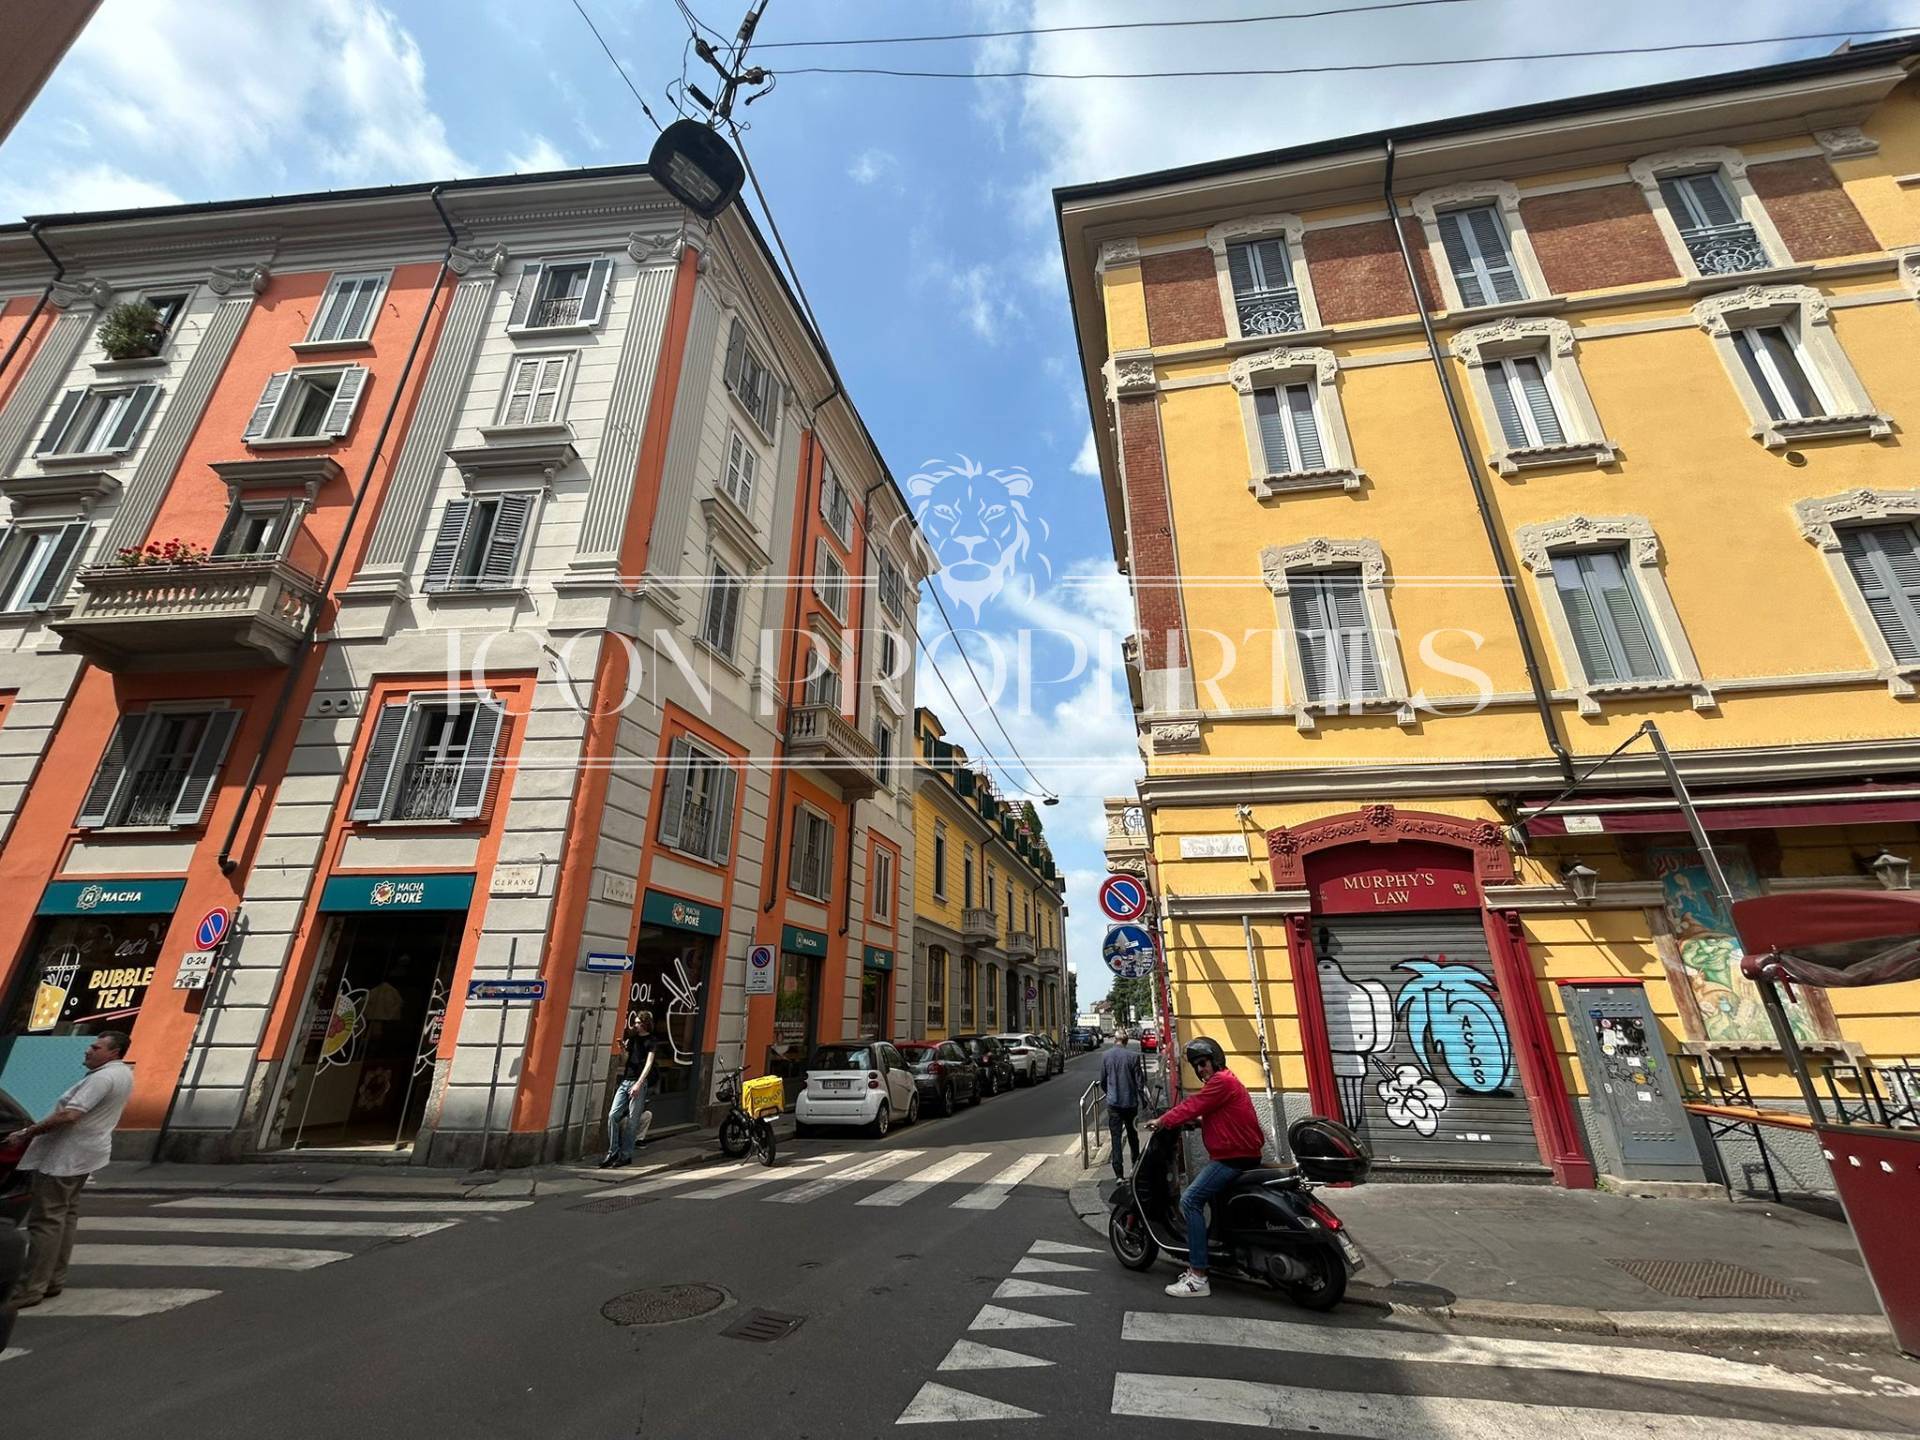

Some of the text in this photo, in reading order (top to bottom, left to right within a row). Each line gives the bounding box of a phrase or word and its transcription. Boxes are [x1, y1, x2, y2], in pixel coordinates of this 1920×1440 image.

[397, 882, 425, 891] MACHA
[1343, 872, 1436, 890] MURPHY'S
[100, 891, 142, 902] MACHA
[1373, 890, 1410, 905] LAW
[88, 966, 155, 989] BUBBLE
[96, 988, 135, 1009] TEA!
